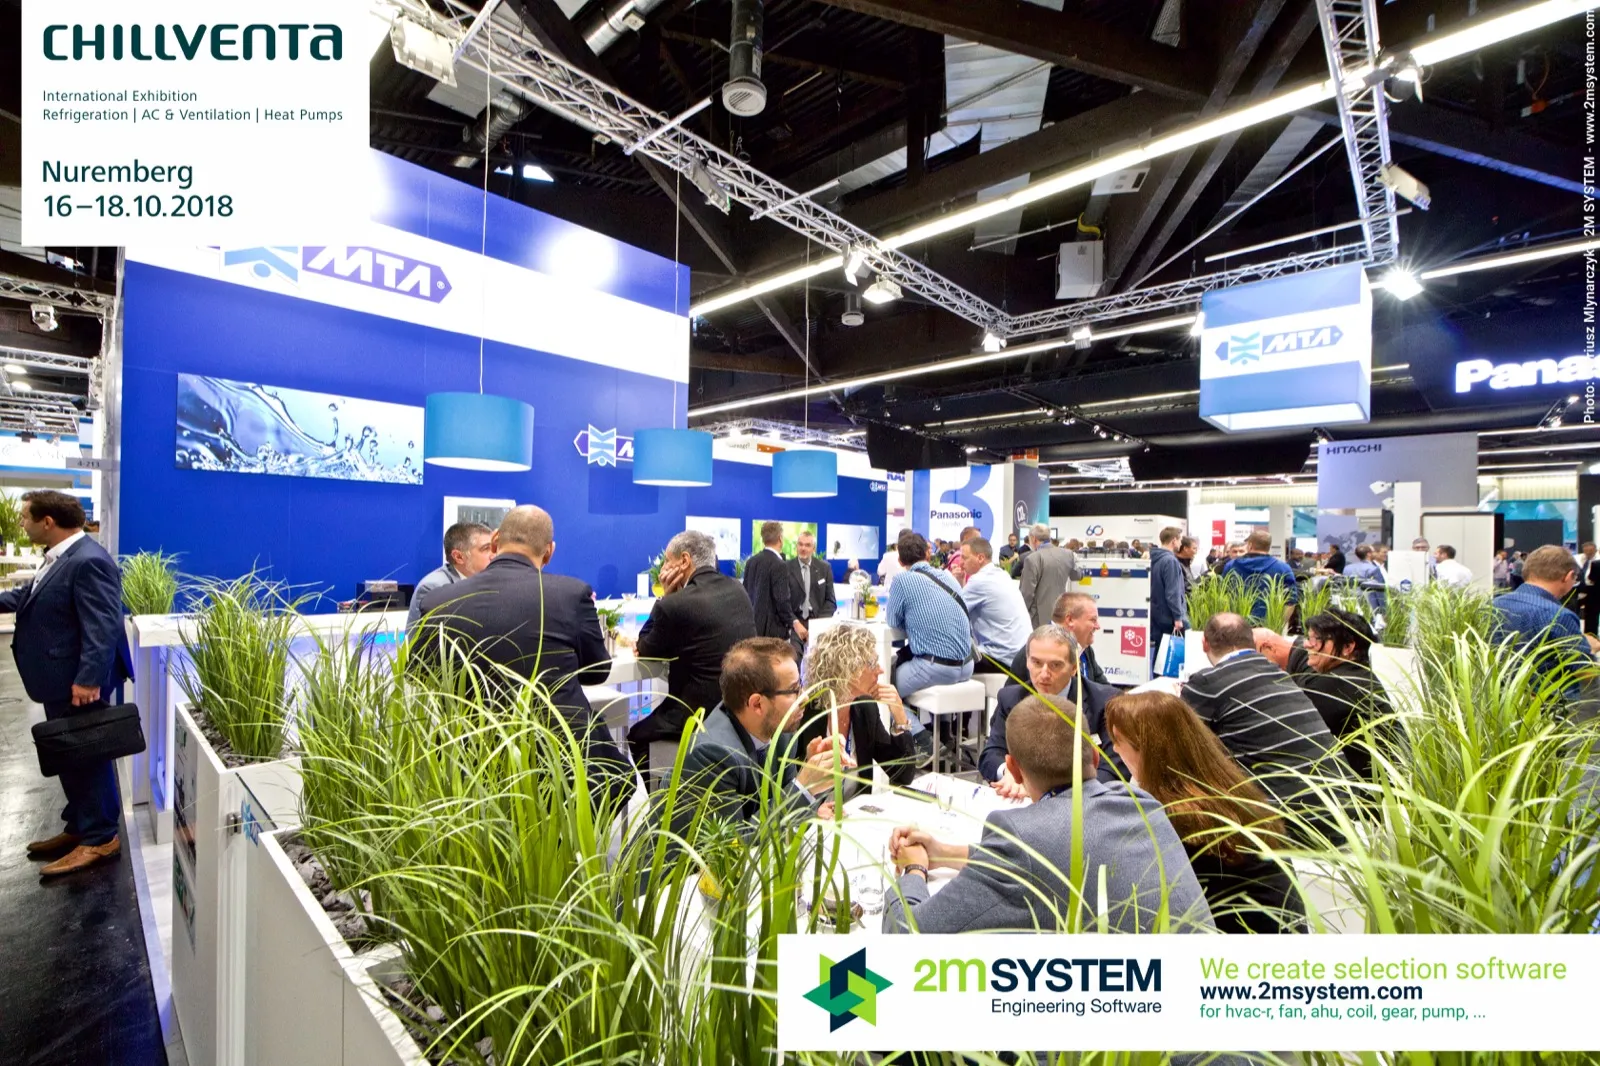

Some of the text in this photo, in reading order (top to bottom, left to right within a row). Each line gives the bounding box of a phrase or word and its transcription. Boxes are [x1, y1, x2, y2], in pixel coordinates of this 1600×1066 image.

[306, 246, 431, 298] MTA
[1264, 328, 1331, 353] MTA
[1326, 443, 1383, 455] HITACHI
[930, 508, 983, 519] Panasonic
